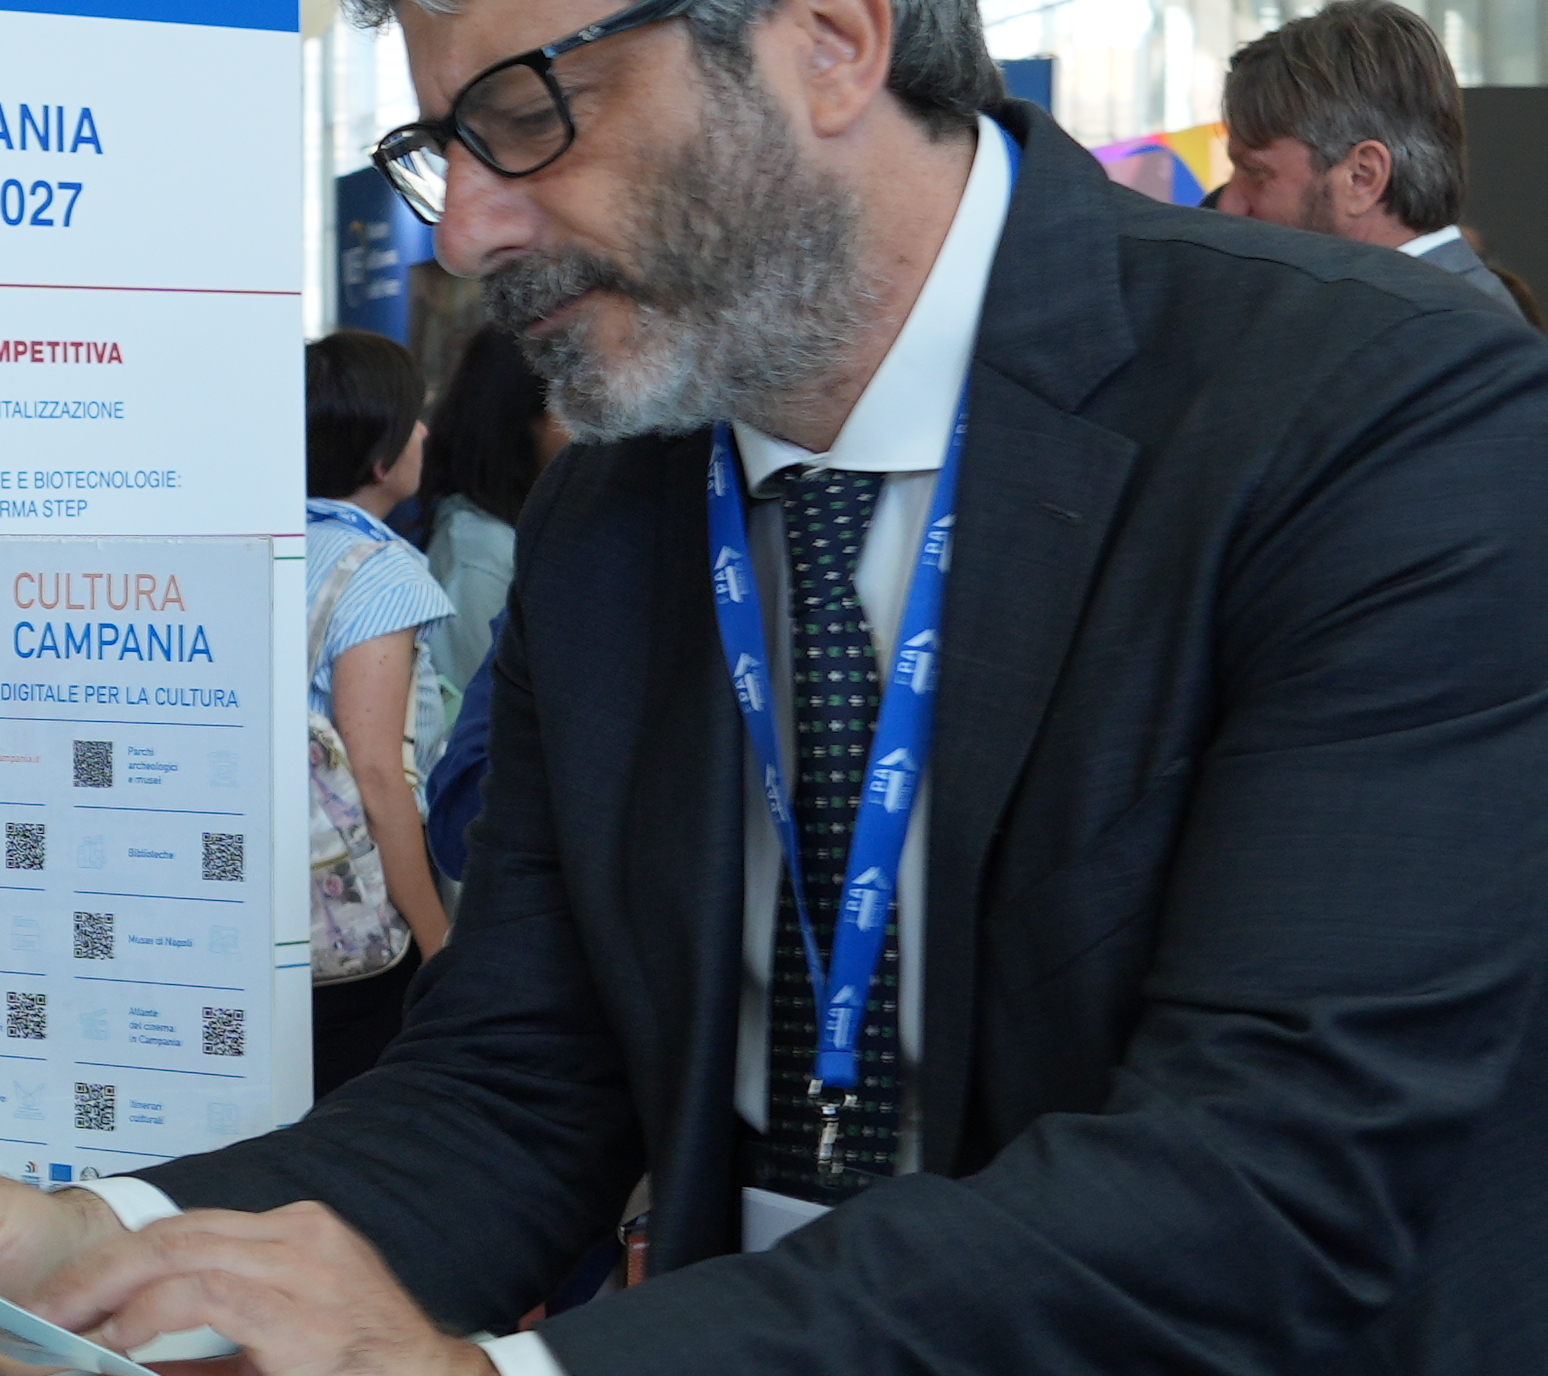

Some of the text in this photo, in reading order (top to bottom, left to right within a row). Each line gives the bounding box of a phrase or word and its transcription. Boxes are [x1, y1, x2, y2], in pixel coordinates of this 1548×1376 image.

[17, 472, 28, 489] E
[35, 468, 181, 489] BIOTECNOLOGIE:
[42, 500, 88, 518] STEP
[14, 572, 186, 612] CULTURA
[14, 622, 214, 663] CAMPANIA
[0, 683, 79, 703] DIGITALE
[85, 686, 120, 704] PER
[126, 687, 150, 705] LA
[155, 688, 239, 708] CULTURA
[128, 746, 154, 757] Parchi
[128, 762, 178, 773] archeologici
[135, 776, 162, 784] musei
[128, 848, 174, 859] Biblioteche
[128, 935, 193, 948] Musei di Napoli
[129, 1007, 159, 1017] Atlante
[129, 1022, 174, 1032] del cinema
[139, 1035, 181, 1047] Campania
[129, 1114, 164, 1124] culturali
